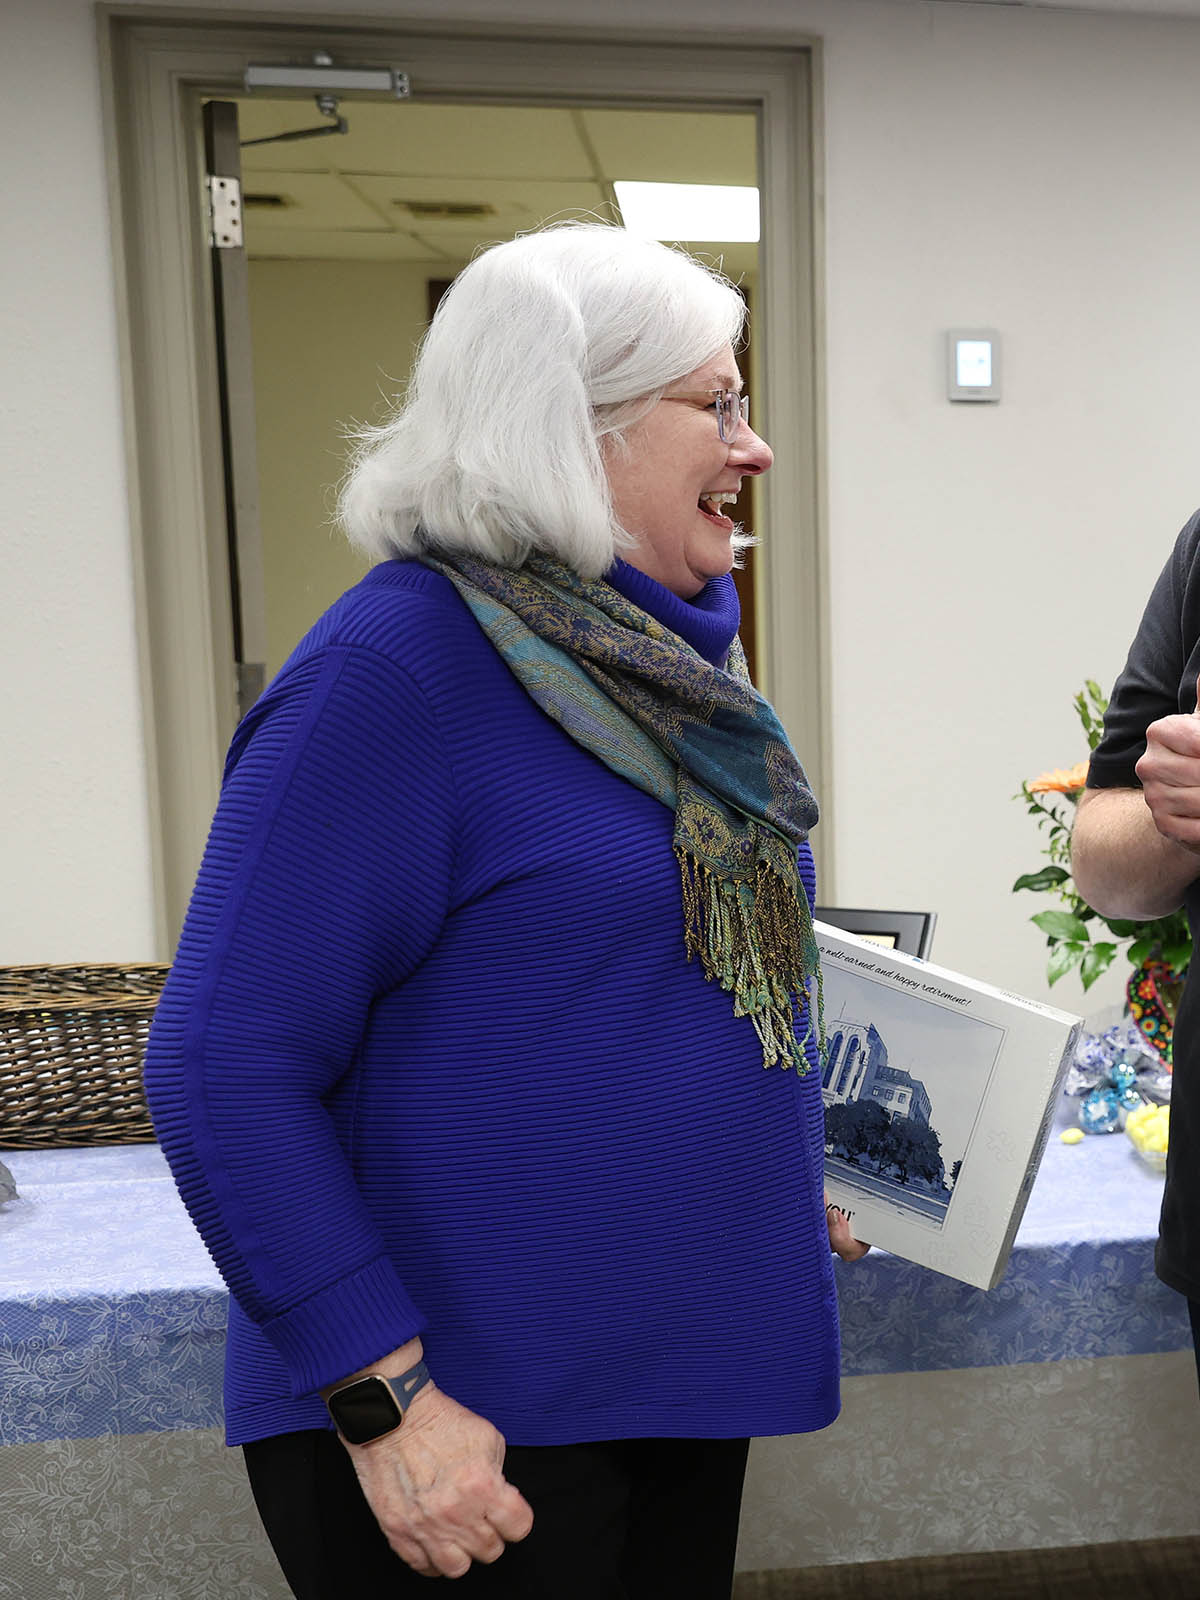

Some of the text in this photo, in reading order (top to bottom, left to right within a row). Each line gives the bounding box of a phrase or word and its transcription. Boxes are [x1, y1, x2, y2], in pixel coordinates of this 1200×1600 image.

[875, 965, 894, 978] and
[893, 972, 920, 989] happy
[921, 983, 972, 1007] retirement!
